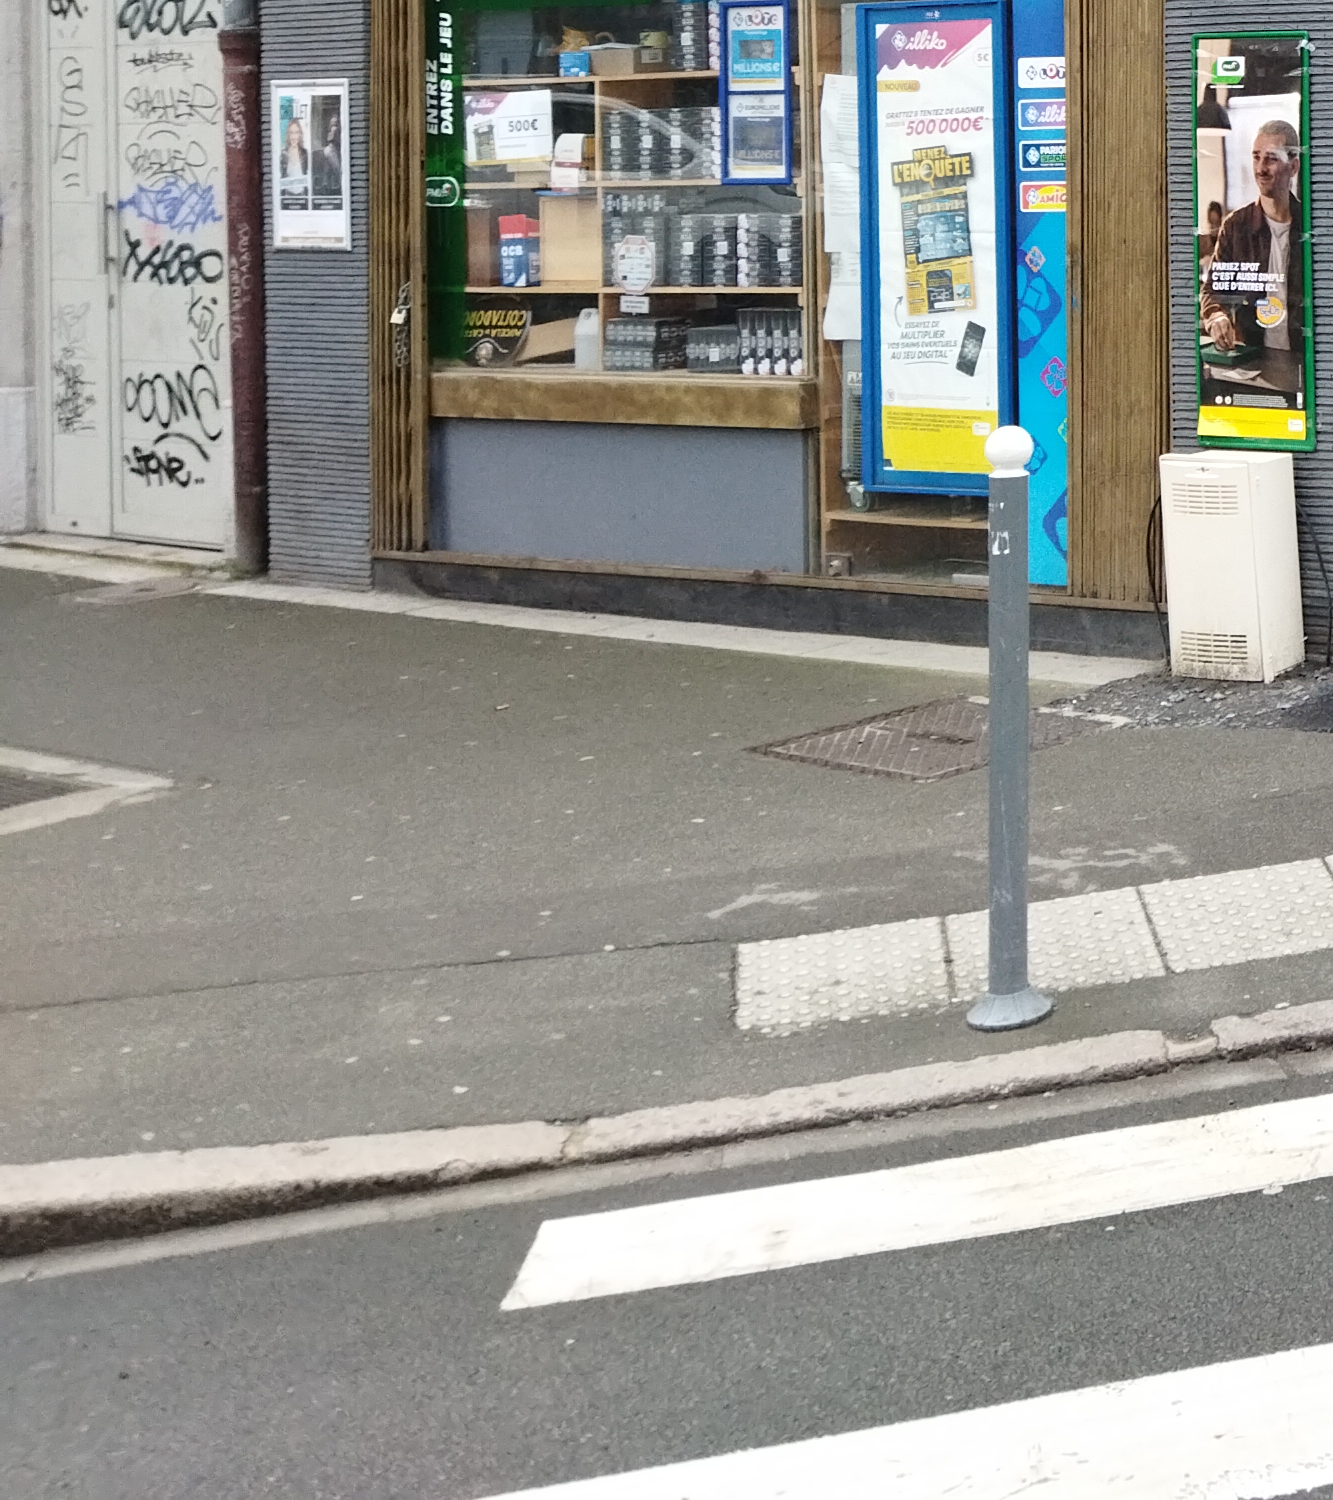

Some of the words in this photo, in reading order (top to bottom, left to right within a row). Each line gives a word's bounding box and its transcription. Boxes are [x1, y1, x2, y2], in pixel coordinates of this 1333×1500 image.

[745, 9, 778, 26] LOTO
[439, 12, 453, 49] JEU
[905, 29, 947, 50] illiko
[440, 51, 453, 75] LE
[733, 62, 772, 74] MILLIONS
[884, 82, 917, 91] NOUVEAU
[425, 58, 438, 135] ENTREZ
[440, 78, 453, 135] DANS
[885, 110, 914, 120] GRATTEZ
[920, 108, 944, 117] TENTEZ
[507, 118, 539, 133] 500€
[905, 119, 937, 137] 500
[500, 244, 523, 257] OCB
[1212, 262, 1239, 271] PARIEZ
[1240, 262, 1260, 272] SPOT
[1212, 282, 1230, 291] QUE
[899, 330, 945, 339] MULTIPLIER
[890, 351, 901, 360] AU
[903, 350, 916, 359] JEU
[917, 349, 948, 359] DIGITAL
